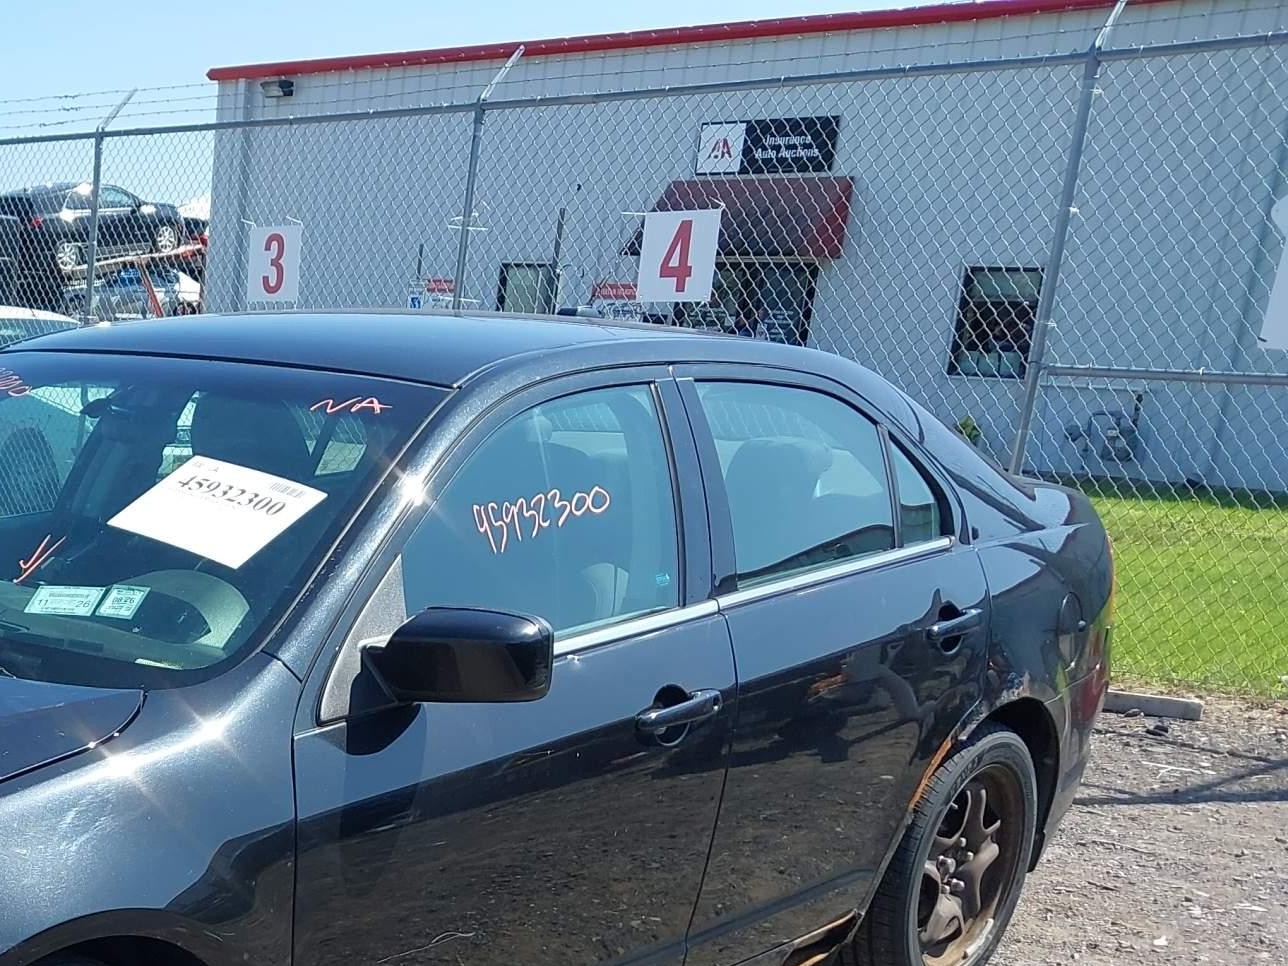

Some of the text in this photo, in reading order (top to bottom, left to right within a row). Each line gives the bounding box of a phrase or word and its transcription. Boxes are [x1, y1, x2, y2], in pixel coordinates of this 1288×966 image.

[754, 147, 820, 159] Auto Auctions
[766, 134, 812, 146] Insurance
[262, 233, 285, 294] 3
[659, 219, 693, 293] 4
[309, 396, 393, 414] NA
[177, 475, 287, 516] 45932300
[473, 485, 611, 553] 45932300
